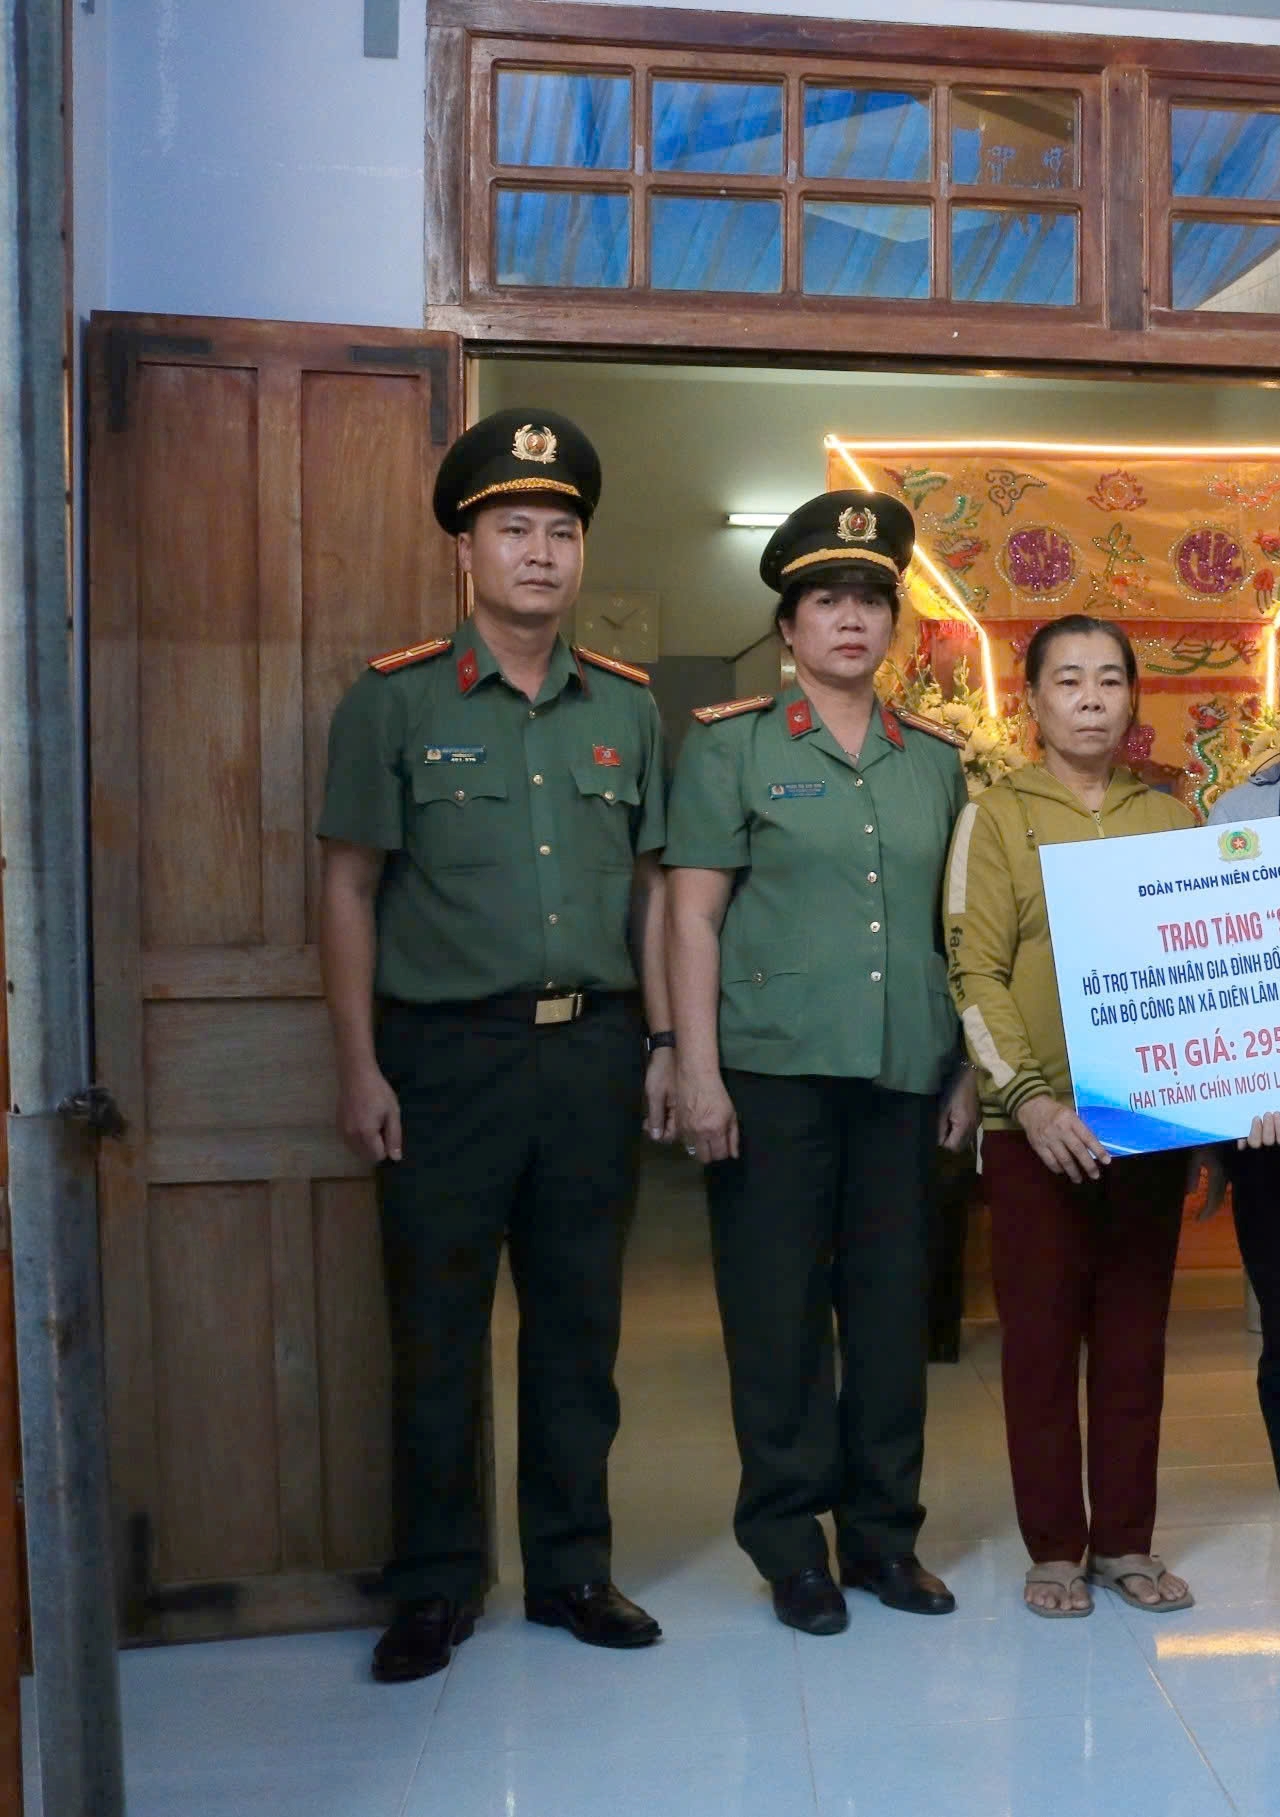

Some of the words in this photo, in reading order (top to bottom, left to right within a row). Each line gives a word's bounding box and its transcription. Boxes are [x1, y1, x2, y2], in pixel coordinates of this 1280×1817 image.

[1138, 879, 1174, 897] ĐOÀN
[1175, 876, 1219, 892] THANH
[1220, 869, 1250, 886] NIÊN
[1157, 919, 1209, 952] TRAO
[1210, 912, 1263, 947] TẶNG
[1082, 969, 1101, 996] HỖ
[1103, 971, 1129, 994] TRỢ
[1131, 965, 1166, 990] THÂN
[1168, 960, 1205, 985] NHÂN
[1207, 959, 1229, 980] GIA
[1231, 953, 1262, 976] ĐÌNH
[1090, 1002, 1118, 1027] CÁN
[1120, 999, 1138, 1025] BỘ
[1140, 997, 1175, 1021] CÔNG
[1178, 994, 1196, 1016] AN
[1198, 988, 1217, 1013] XÃ
[1218, 985, 1250, 1010] DIÊN
[1135, 1042, 1179, 1076] TRỊ
[1184, 1028, 1238, 1067] GIÁ:
[1128, 1089, 1157, 1113] (HAI
[1159, 1082, 1197, 1108] TRĂM
[1199, 1075, 1232, 1101] CHÍN
[1234, 1070, 1272, 1096] MƯƠI
